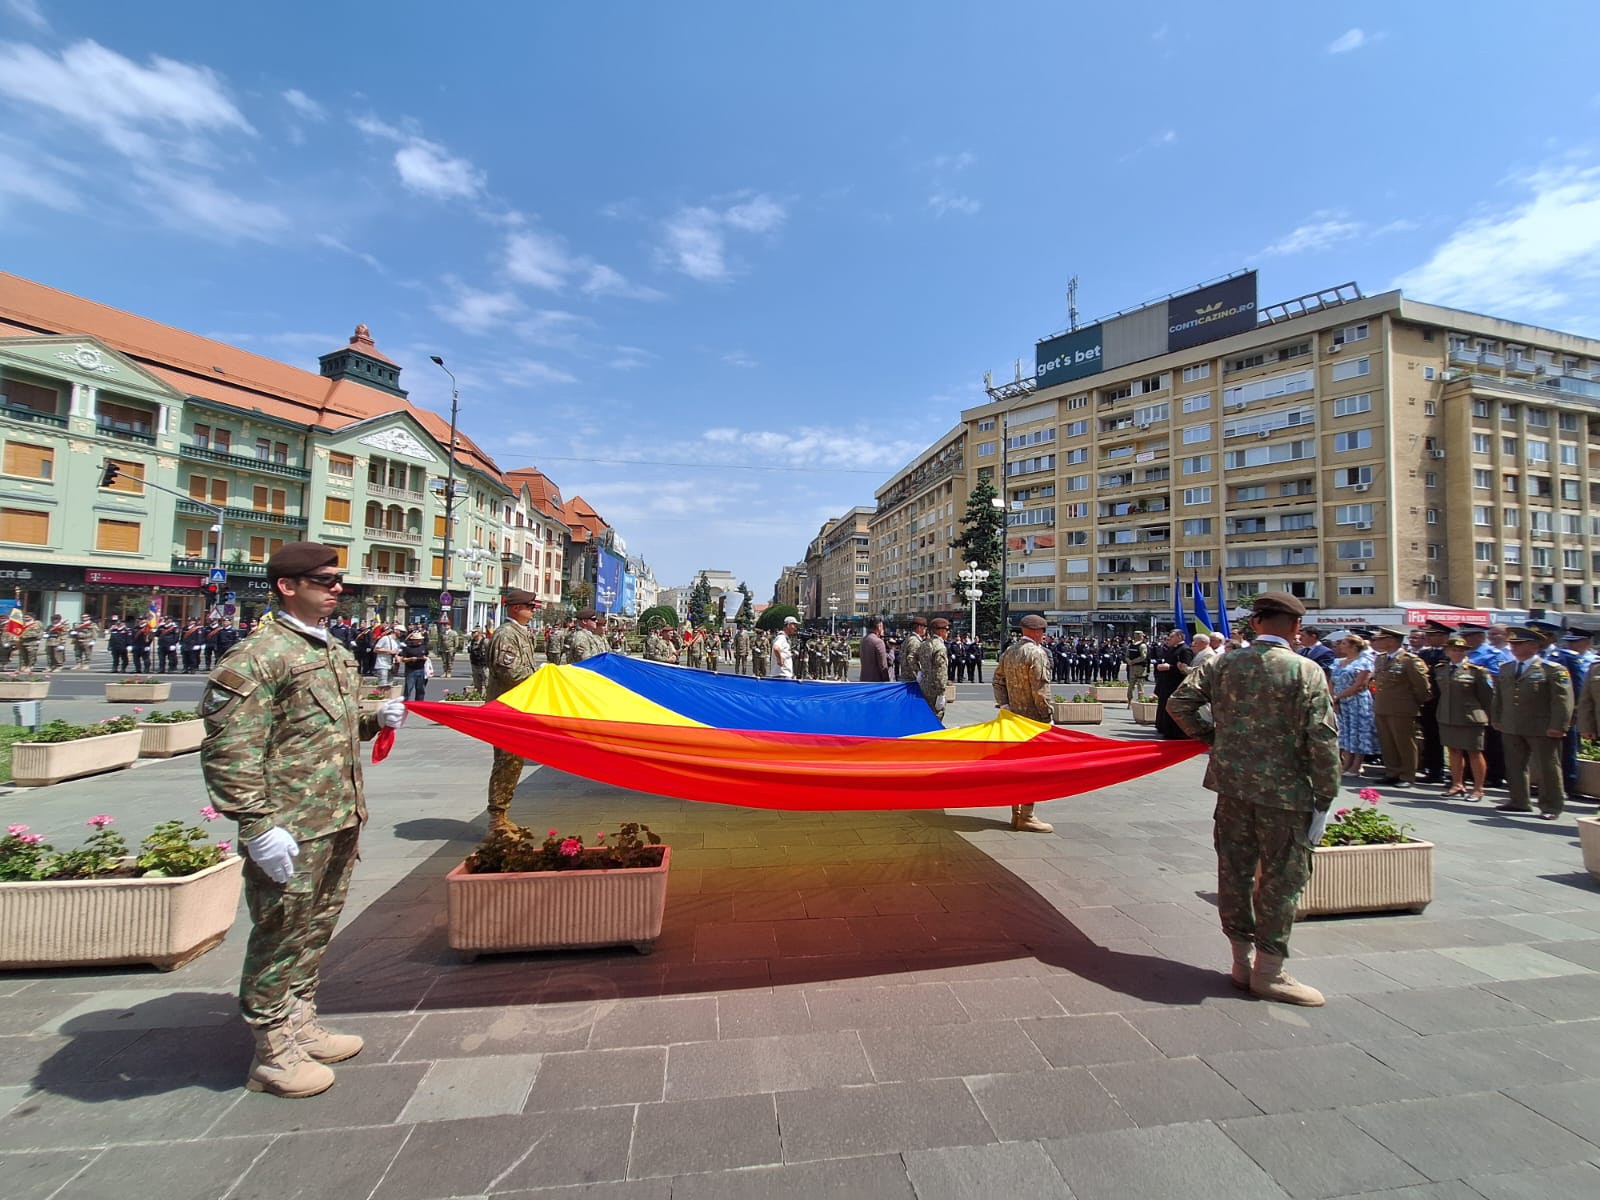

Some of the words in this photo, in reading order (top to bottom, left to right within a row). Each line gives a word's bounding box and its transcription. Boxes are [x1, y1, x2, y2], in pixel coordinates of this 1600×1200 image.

[1169, 302, 1255, 333] CONTICAZINO.RO
[1037, 354, 1072, 377] get's
[1074, 345, 1102, 363] bet
